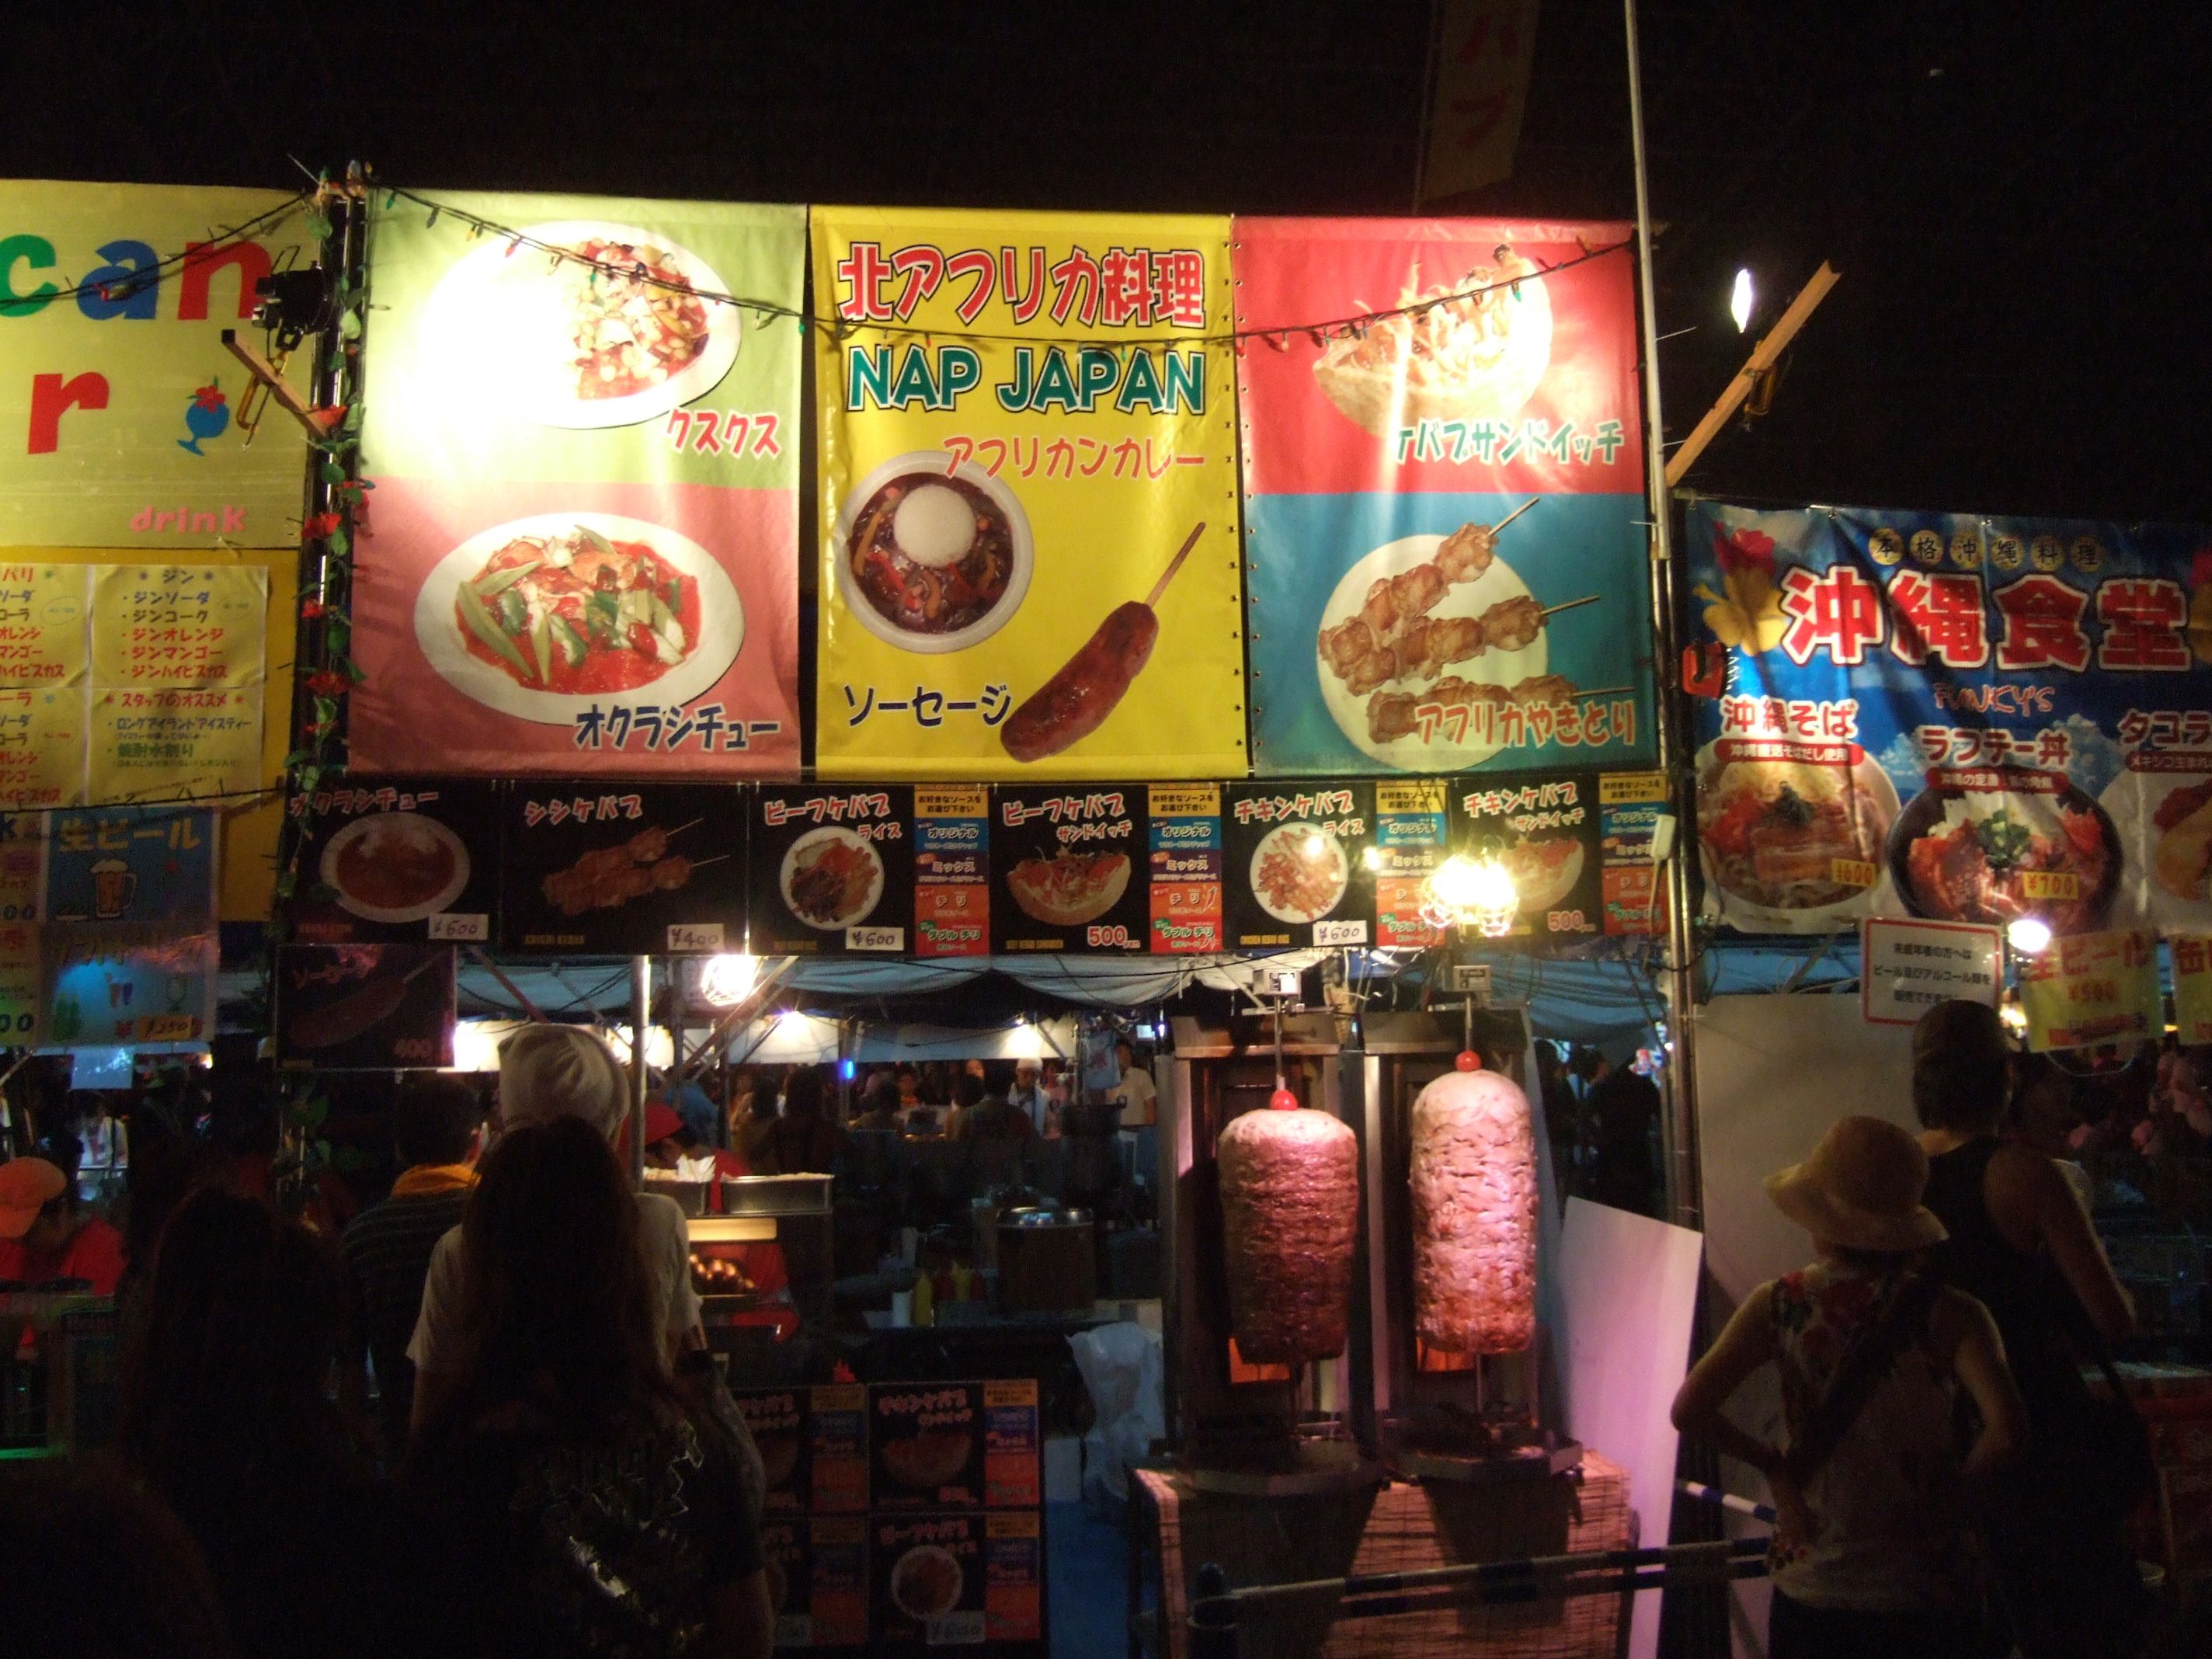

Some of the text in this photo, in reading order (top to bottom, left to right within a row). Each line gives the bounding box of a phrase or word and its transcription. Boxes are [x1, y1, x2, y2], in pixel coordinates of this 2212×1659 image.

[838, 242, 1205, 329] 北アフリカ料理
[847, 343, 1205, 415] NAP JAPAN
[666, 409, 781, 459] クスクス
[943, 435, 1205, 481] アフリカンカレー
[130, 505, 247, 534] drink
[133, 610, 209, 623] ジンコーク
[1782, 565, 2193, 674] 沖縄食堂
[133, 628, 224, 642] ジンオレンジ
[131, 645, 224, 660] ジンマンゴー
[121, 692, 228, 708] スタッフのオススメ
[843, 682, 1011, 726] ソーセージ
[573, 702, 781, 752] オクラシチュー
[1415, 700, 1636, 747] アフリカやきとり
[1720, 695, 1859, 738] 沖縄そば
[1920, 727, 2071, 767] ラフテー丼
[763, 792, 890, 826] ビーフケバブ
[918, 795, 982, 805] お好きなソースを
[927, 805, 974, 813] お選び下さい
[1002, 792, 1125, 826] ビーフケバブ
[1152, 793, 1213, 802] お好きなソースを
[1160, 803, 1207, 812] お選び下さい
[1234, 790, 1355, 824] チキンケバブ
[1463, 781, 1578, 818] チキンケバブ
[524, 794, 643, 828] シシケバブ
[1515, 807, 1585, 833] サンドイッチ
[59, 817, 203, 852] 生ビール
[857, 821, 903, 840] ライス
[1056, 820, 1132, 843] サンドイッチ
[1322, 818, 1366, 837] ライス
[931, 861, 976, 874] ミックス
[1166, 858, 1209, 872] ミックス
[433, 918, 478, 937] ¥600
[671, 927, 719, 948] ¥400
[851, 930, 896, 947] ¥600
[1319, 927, 1361, 943] ¥600
